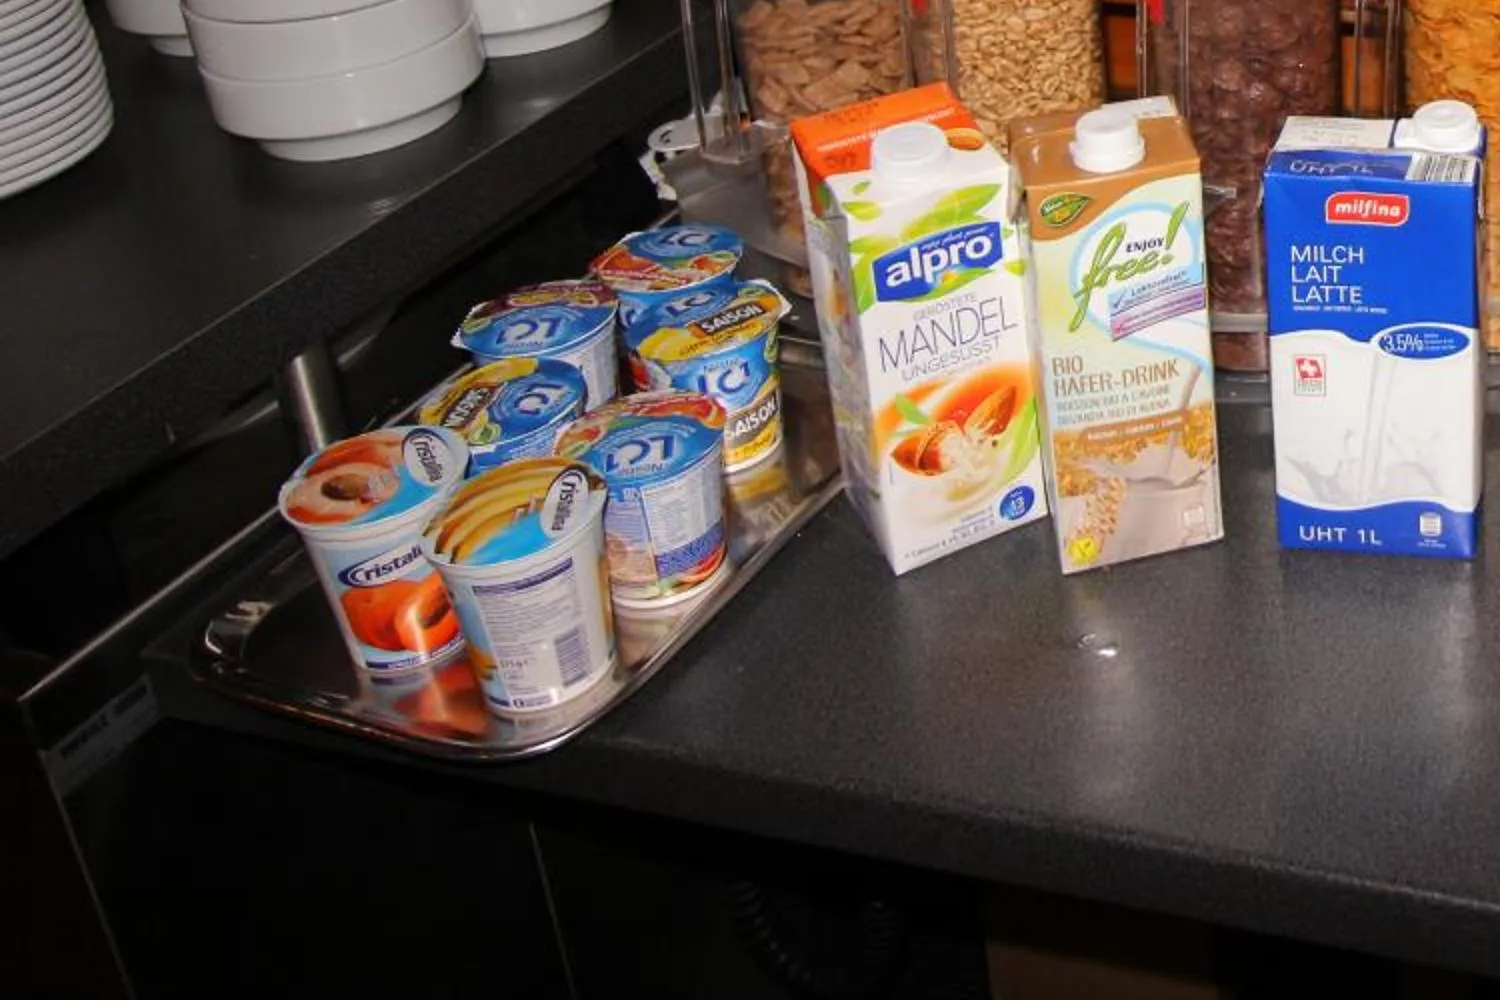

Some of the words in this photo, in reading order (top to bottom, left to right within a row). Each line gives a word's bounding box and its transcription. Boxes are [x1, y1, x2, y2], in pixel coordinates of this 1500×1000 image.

[1335, 199, 1402, 218] milfina
[1126, 237, 1165, 253] ENJOY
[1291, 244, 1364, 264] MILCH
[886, 234, 992, 287] alpro
[1291, 265, 1342, 284] LAIT
[1292, 285, 1363, 304] LATTE
[701, 302, 763, 333] SAISON
[879, 295, 1019, 373] MANDEL
[1052, 355, 1084, 376] BIO
[1053, 358, 1180, 397] HAFER-DRINK
[1299, 524, 1347, 543] UHT
